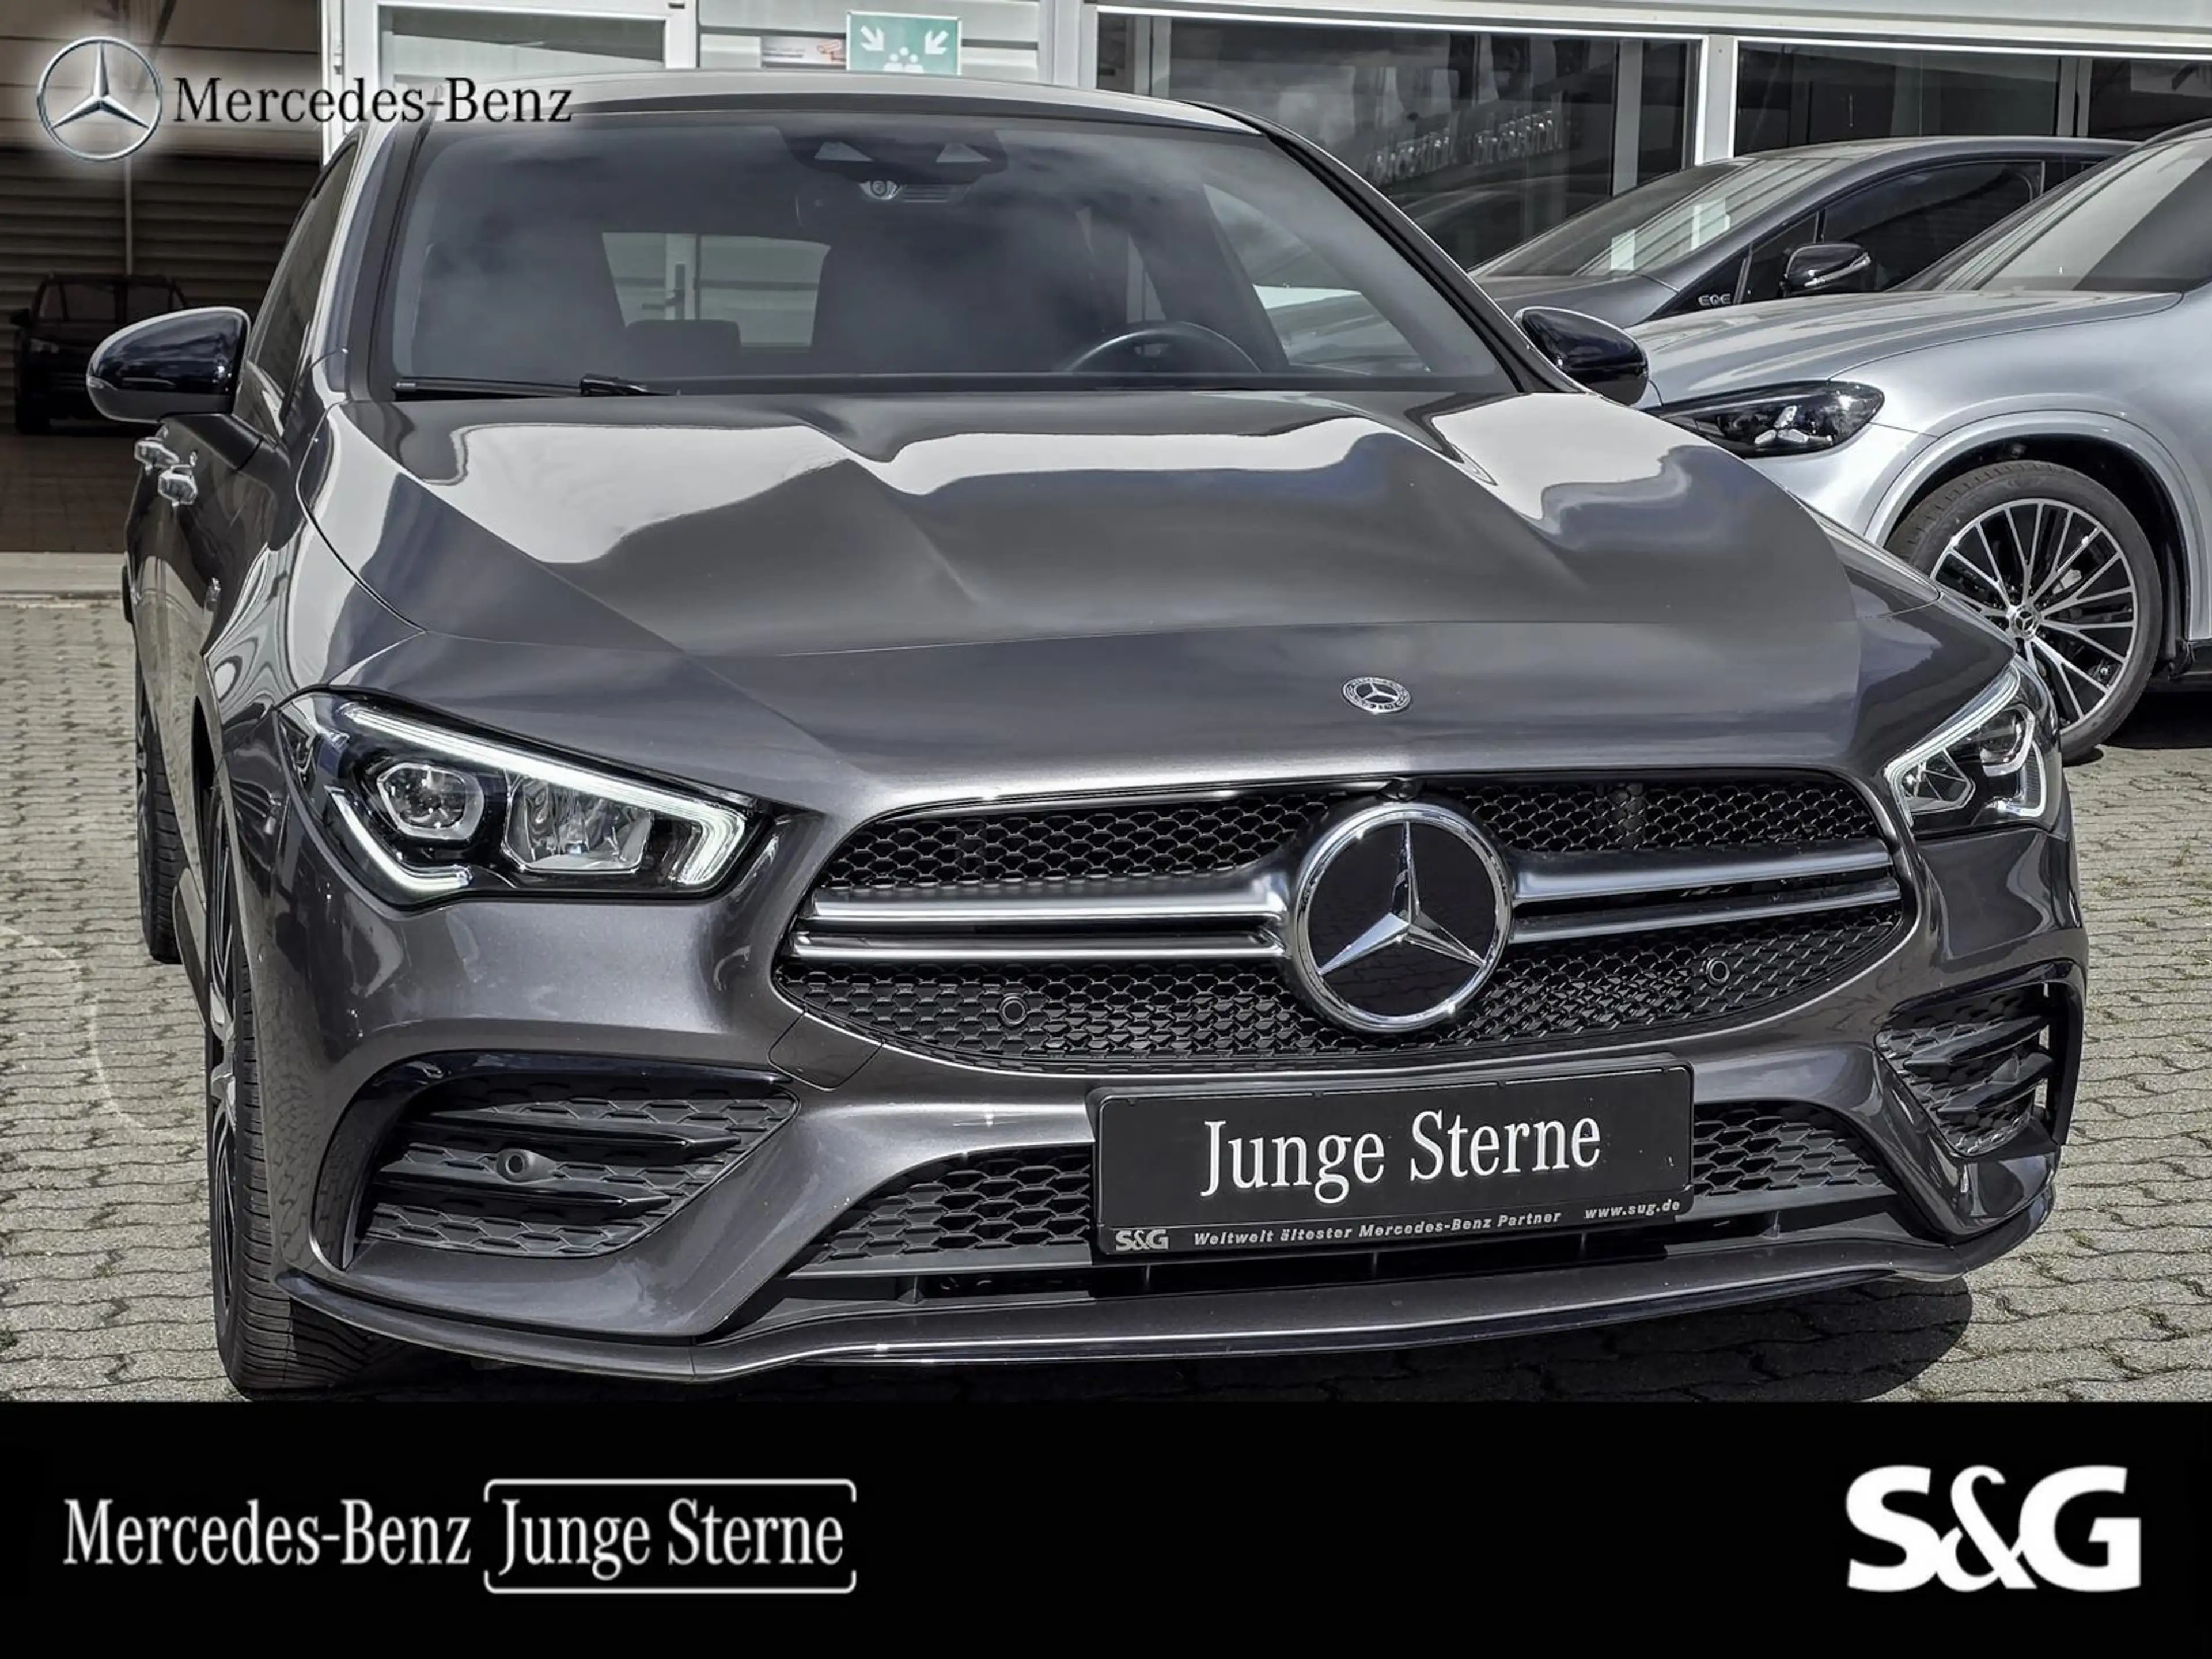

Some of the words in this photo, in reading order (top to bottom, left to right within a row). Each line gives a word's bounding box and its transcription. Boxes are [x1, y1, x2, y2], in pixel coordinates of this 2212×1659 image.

[1698, 293, 1732, 306] EQE
[1200, 1120, 1385, 1204] Junge
[1410, 1109, 1600, 1181] Sterne
[1584, 1199, 1680, 1219] www.sug.de
[1280, 1227, 1353, 1242] ältester
[1358, 1218, 1491, 1238] Mercedes-Benz
[1497, 1211, 1562, 1228] Partner
[1115, 1229, 1169, 1251] S&G
